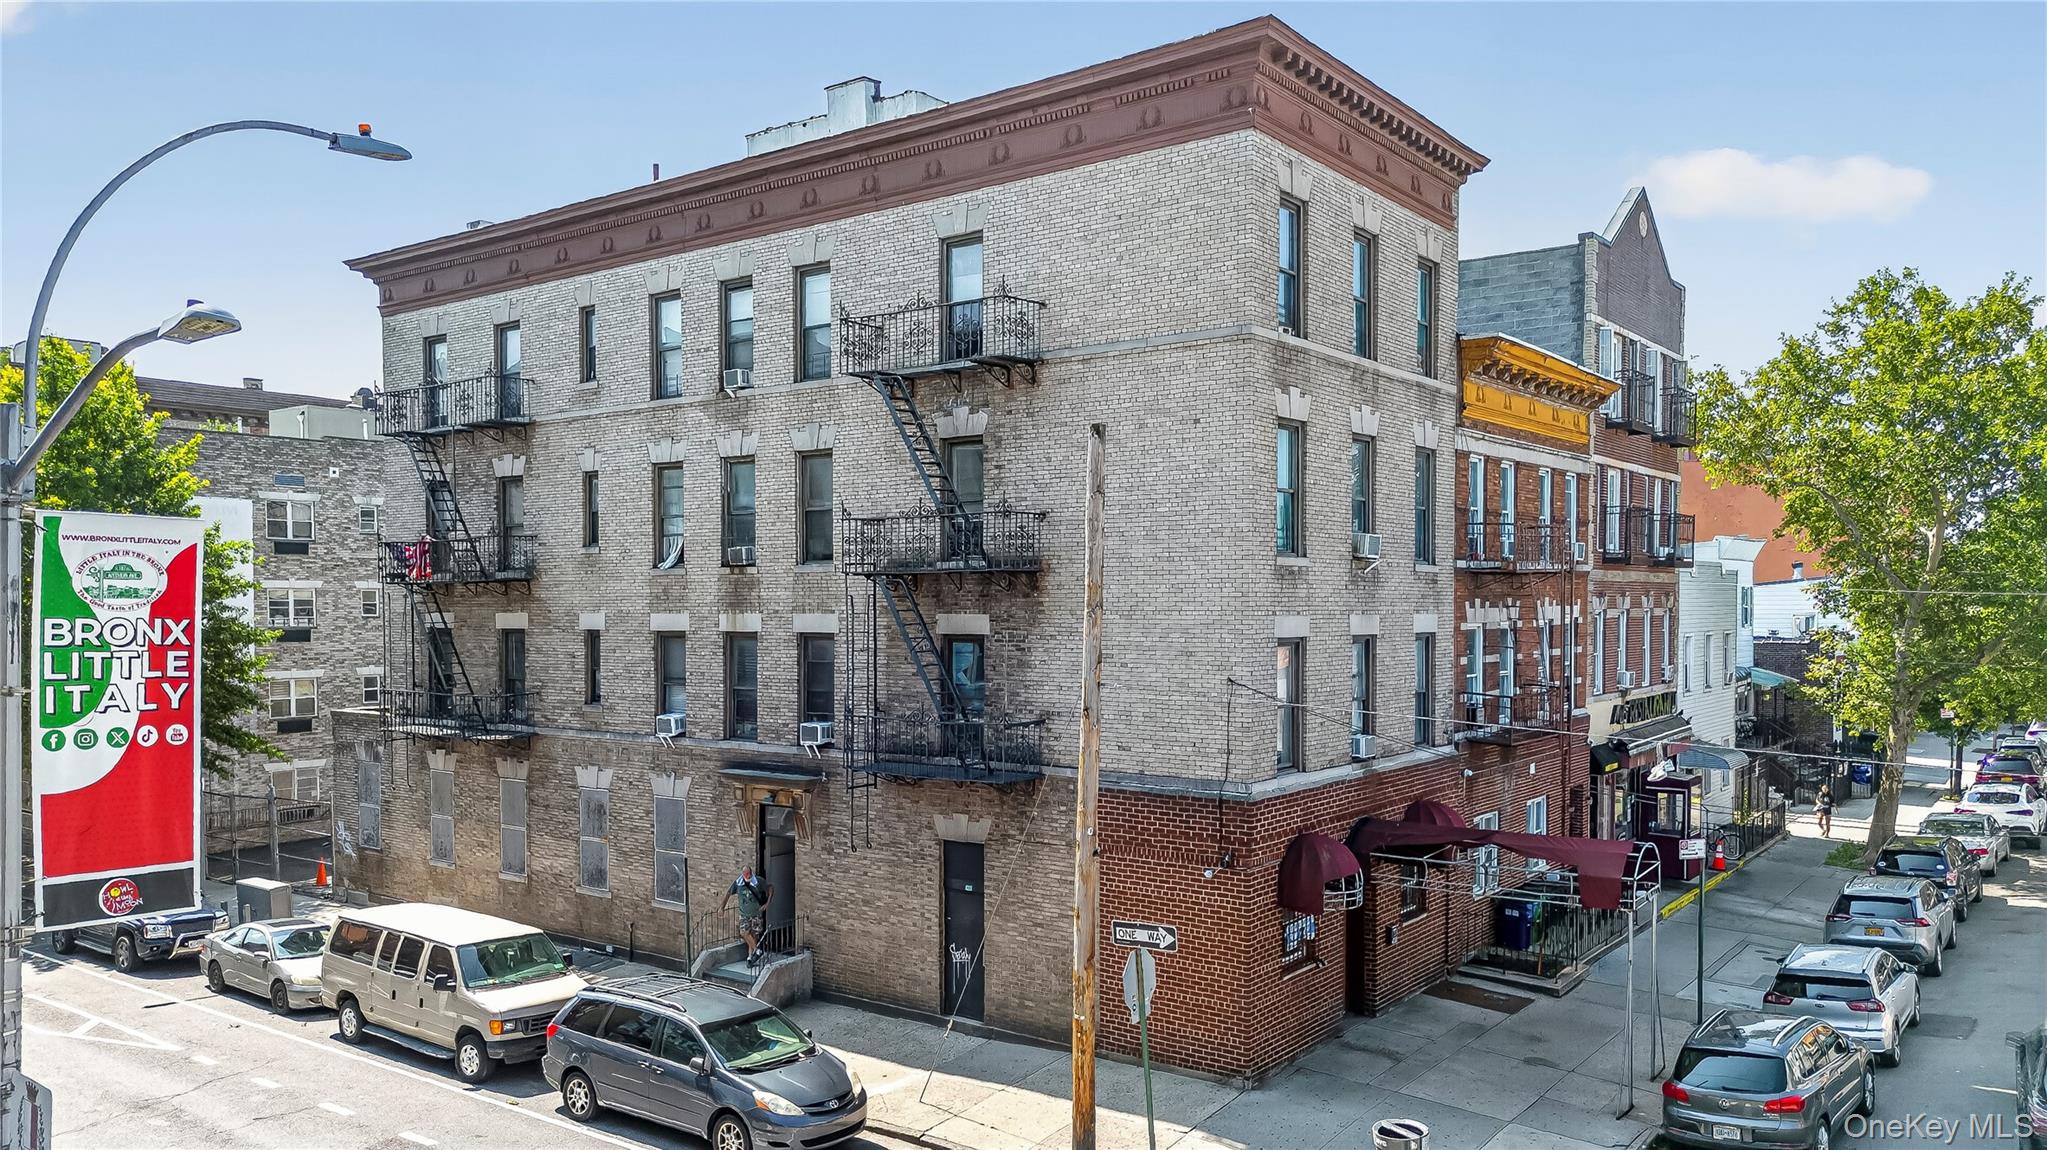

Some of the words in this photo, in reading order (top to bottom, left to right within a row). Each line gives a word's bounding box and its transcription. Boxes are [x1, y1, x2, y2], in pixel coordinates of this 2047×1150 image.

[61, 534, 181, 545] WWW.BRONXLITTLEITALY.COM
[76, 555, 98, 575] LITTLE
[100, 550, 120, 559] ITALY
[43, 617, 191, 647] BRONX
[43, 650, 190, 681] LITTLE
[45, 682, 189, 715] ITALY
[1118, 929, 1137, 939] ONE
[1147, 931, 1167, 942] WAY
